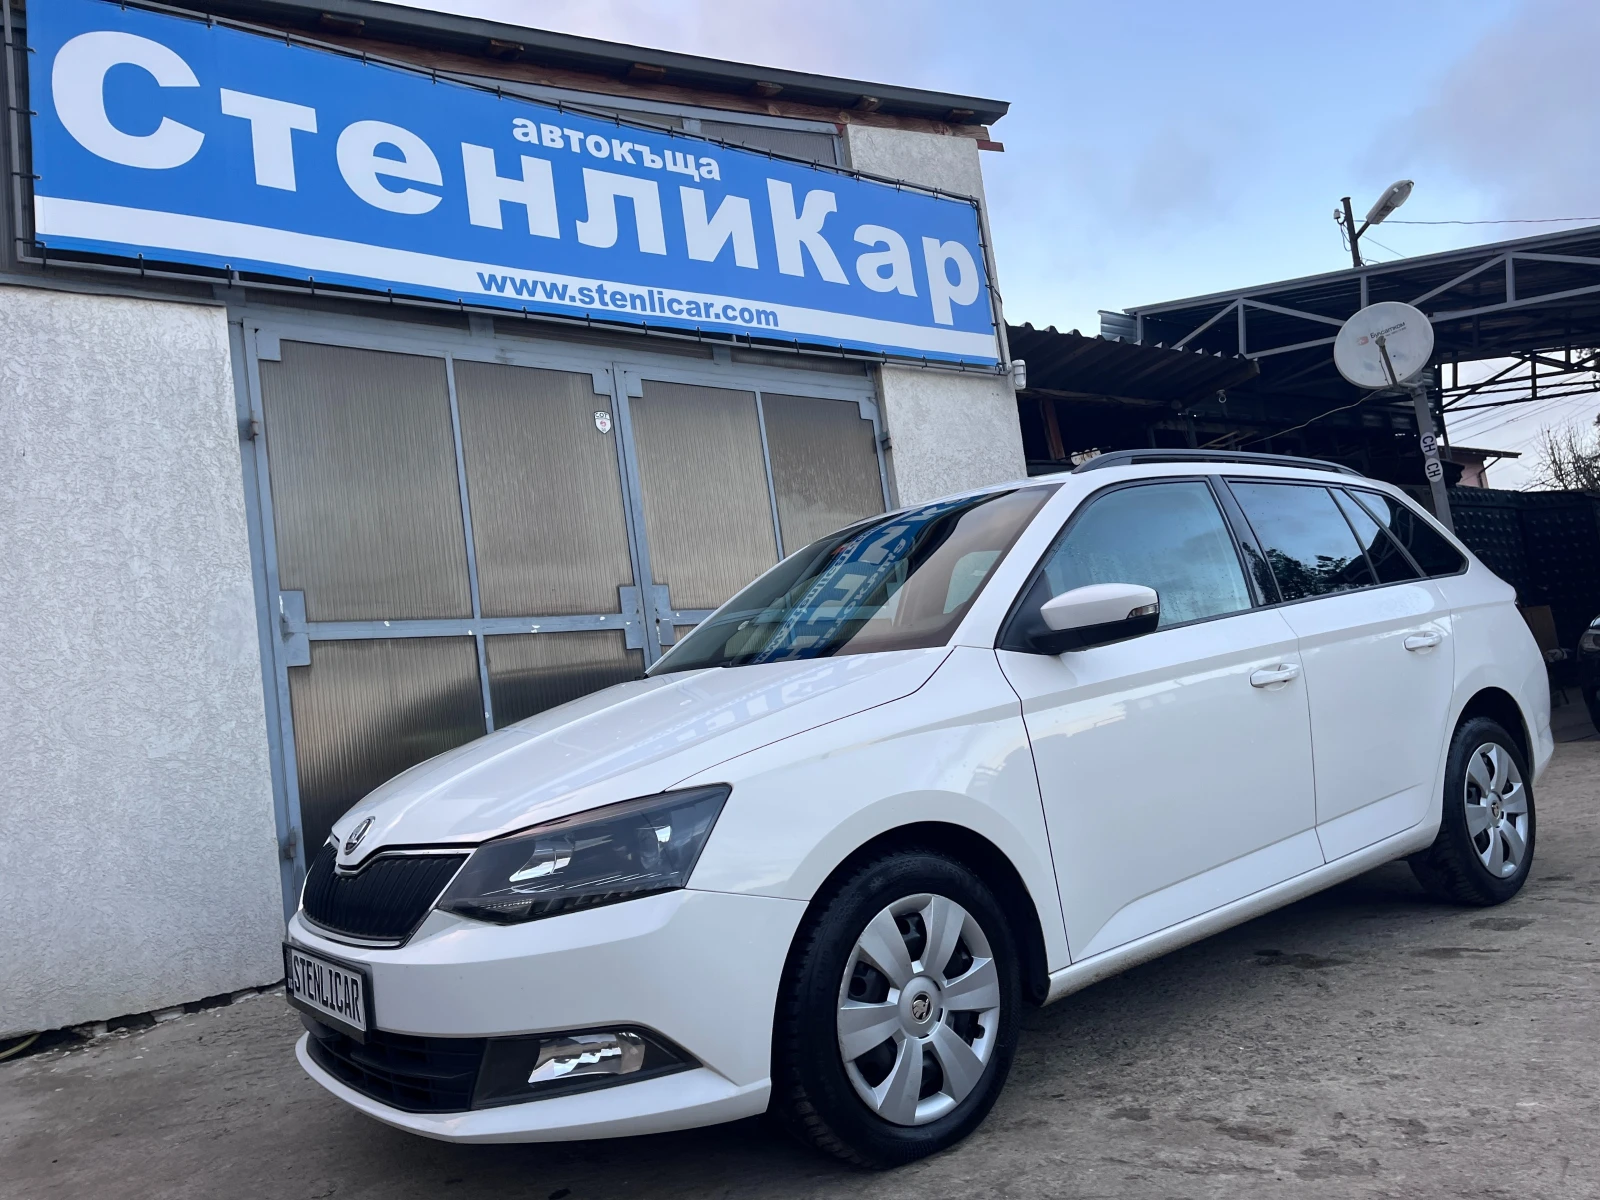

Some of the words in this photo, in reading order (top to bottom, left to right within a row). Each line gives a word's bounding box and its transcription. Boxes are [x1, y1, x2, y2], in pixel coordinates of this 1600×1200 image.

[51, 30, 980, 326] СтенлиКар
[512, 117, 721, 183] автокъща
[476, 271, 779, 328] www.stenlicar.com
[293, 955, 361, 1023] STENLICAR
